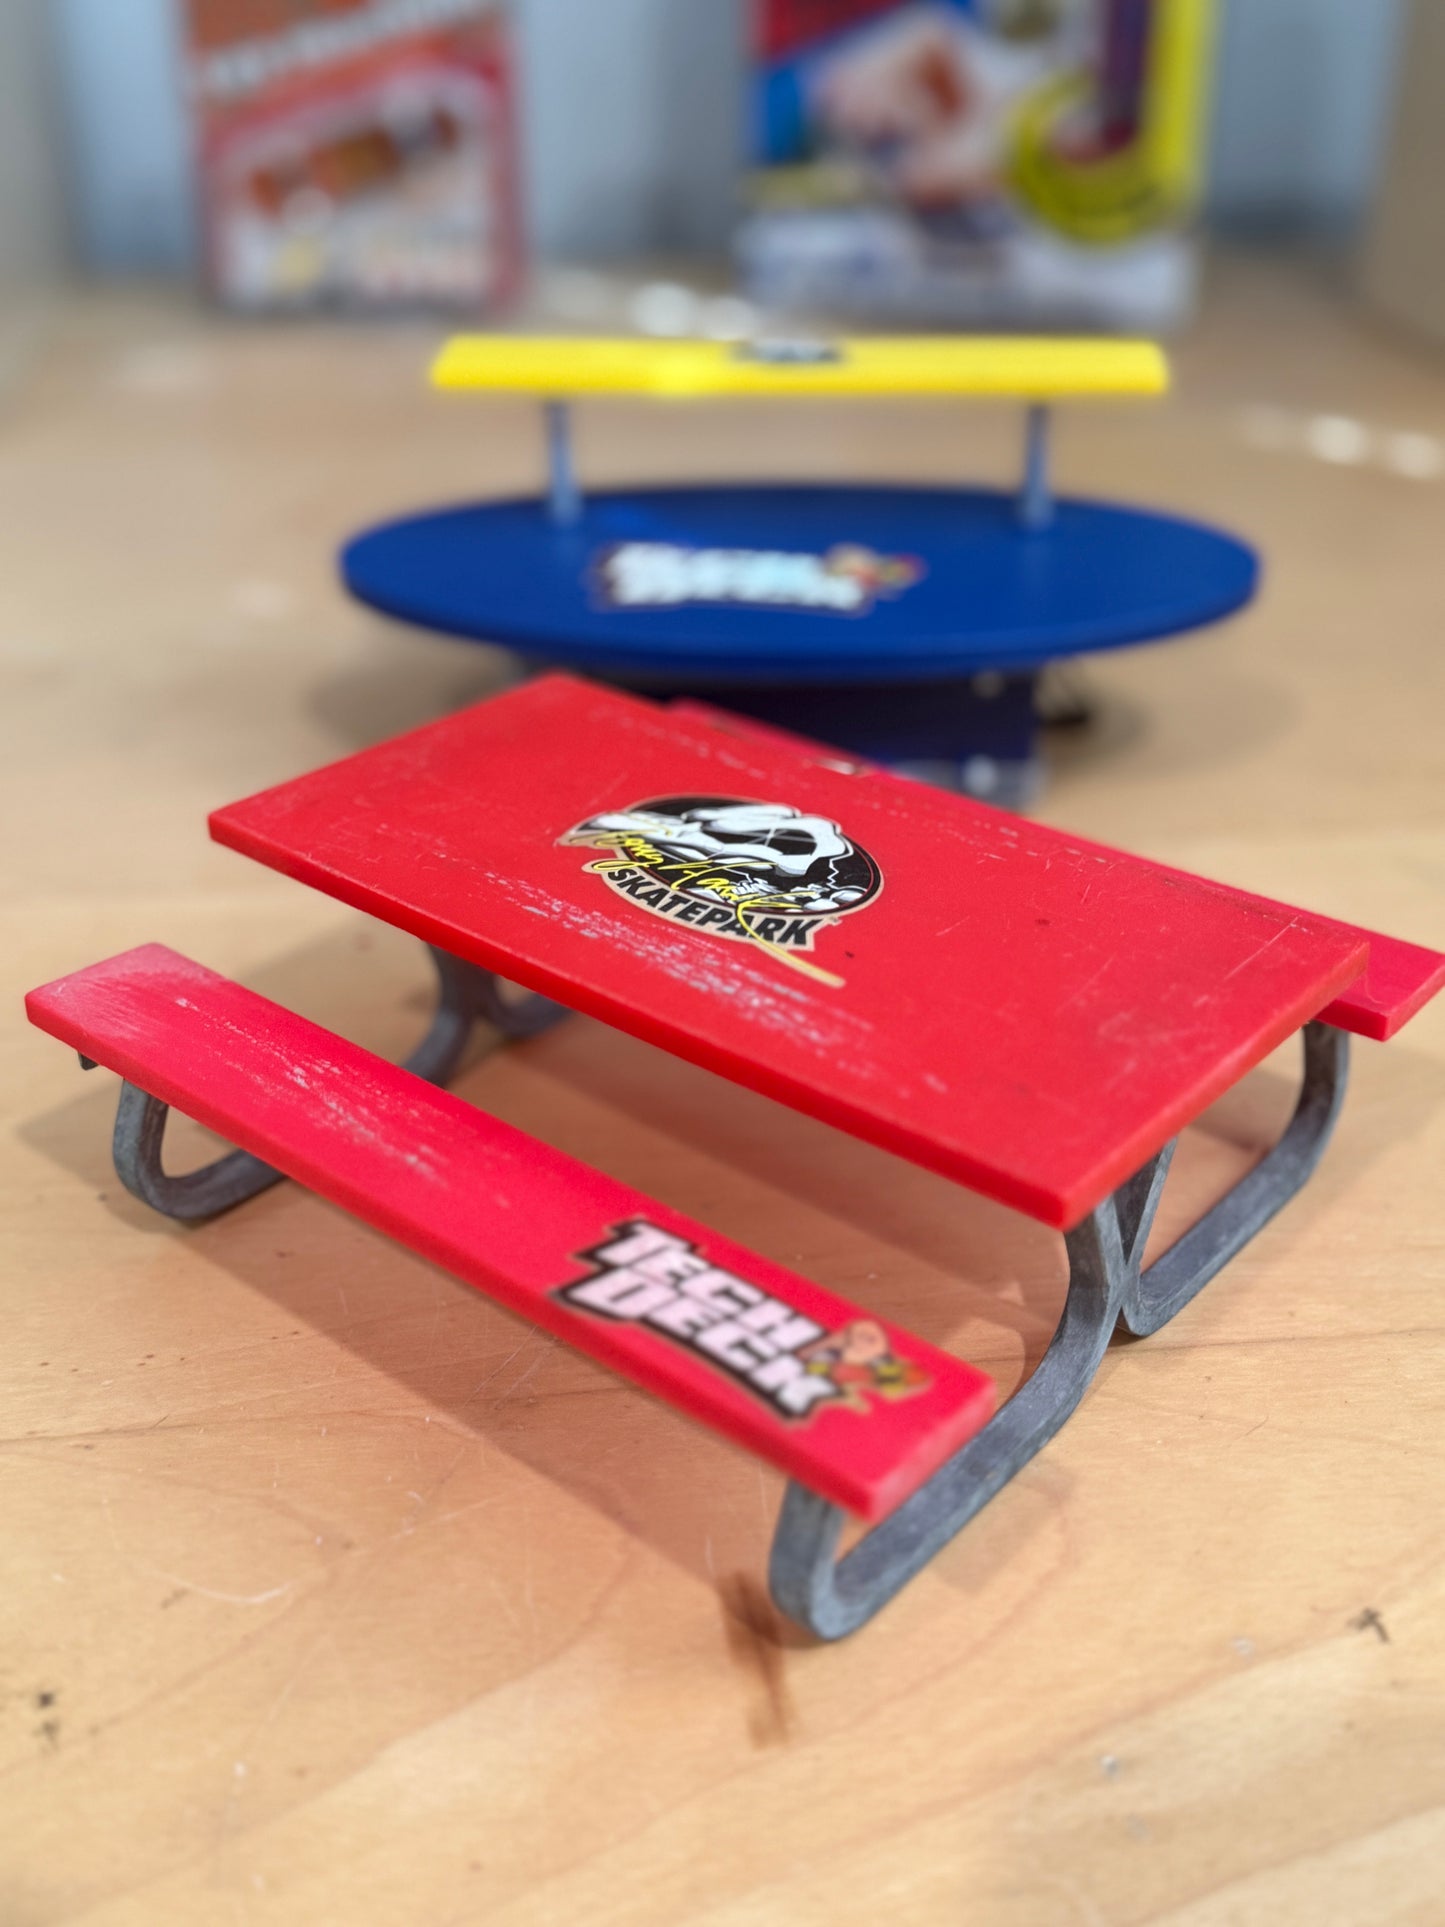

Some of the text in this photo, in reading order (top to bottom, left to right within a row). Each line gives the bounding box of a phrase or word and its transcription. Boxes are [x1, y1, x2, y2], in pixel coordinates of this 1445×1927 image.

[607, 868, 822, 946] SKATEPARK
[564, 1267, 837, 1414] DECK
[590, 1220, 828, 1354] TECH
